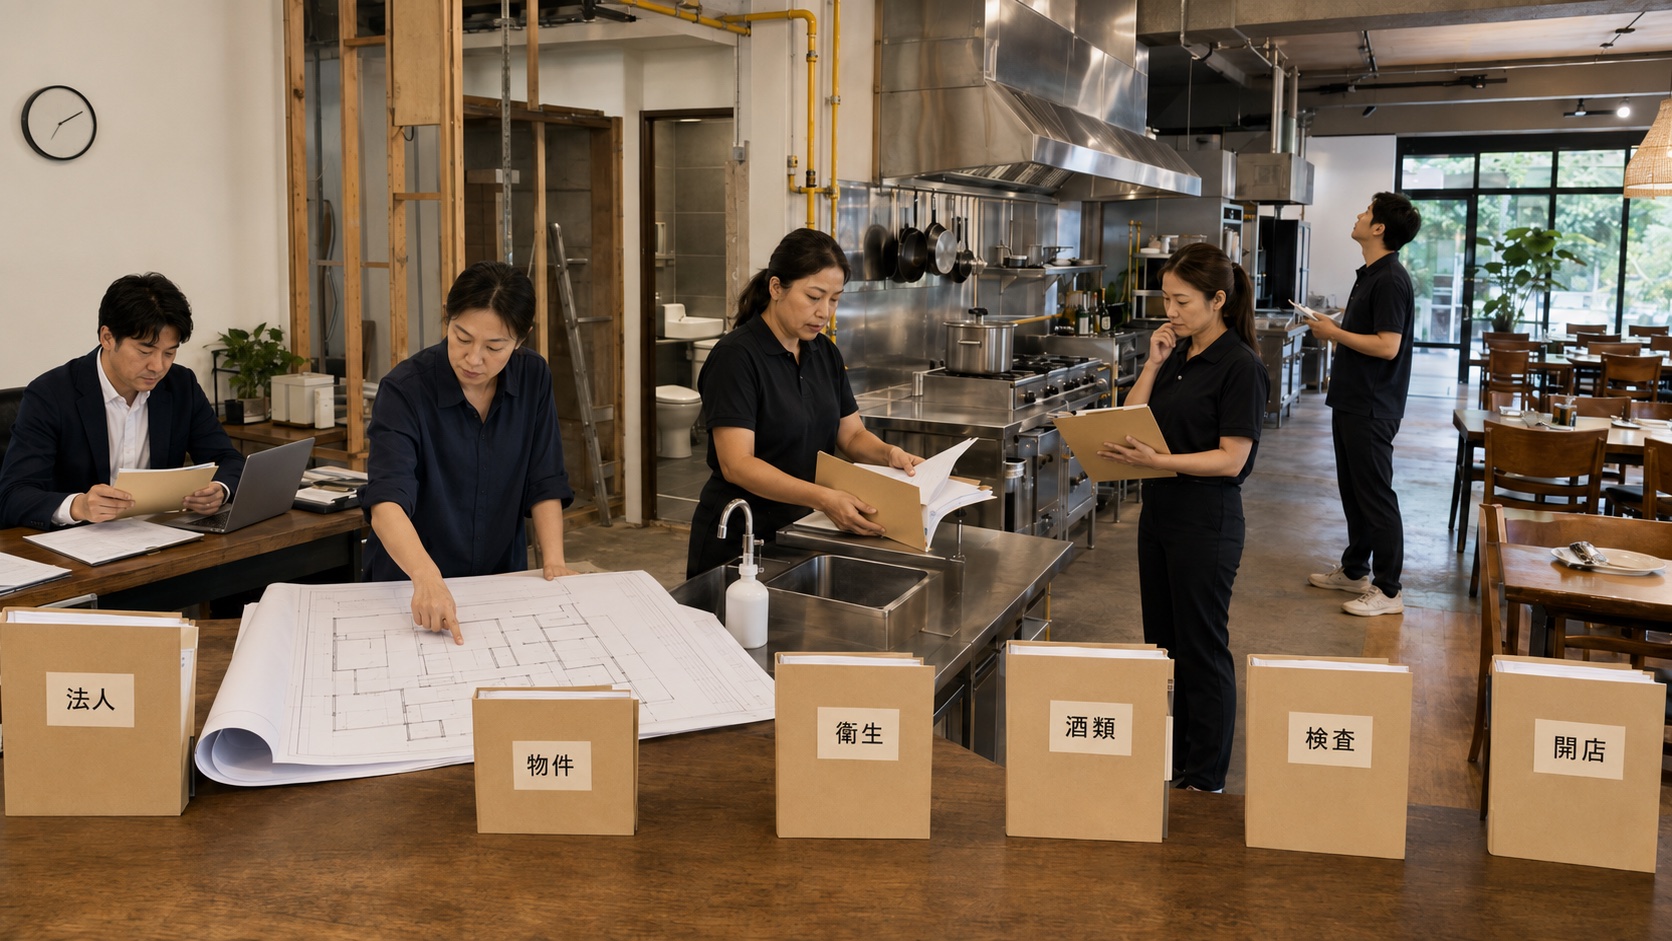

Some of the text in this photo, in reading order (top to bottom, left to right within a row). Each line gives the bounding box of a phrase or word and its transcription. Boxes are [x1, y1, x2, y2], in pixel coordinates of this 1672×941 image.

[66, 686, 116, 711] 法人
[835, 721, 884, 745] 衛生
[1065, 715, 1116, 740] 酒類
[1305, 726, 1355, 752] 検査
[1553, 735, 1606, 762] 開店
[526, 753, 575, 777] 物件
